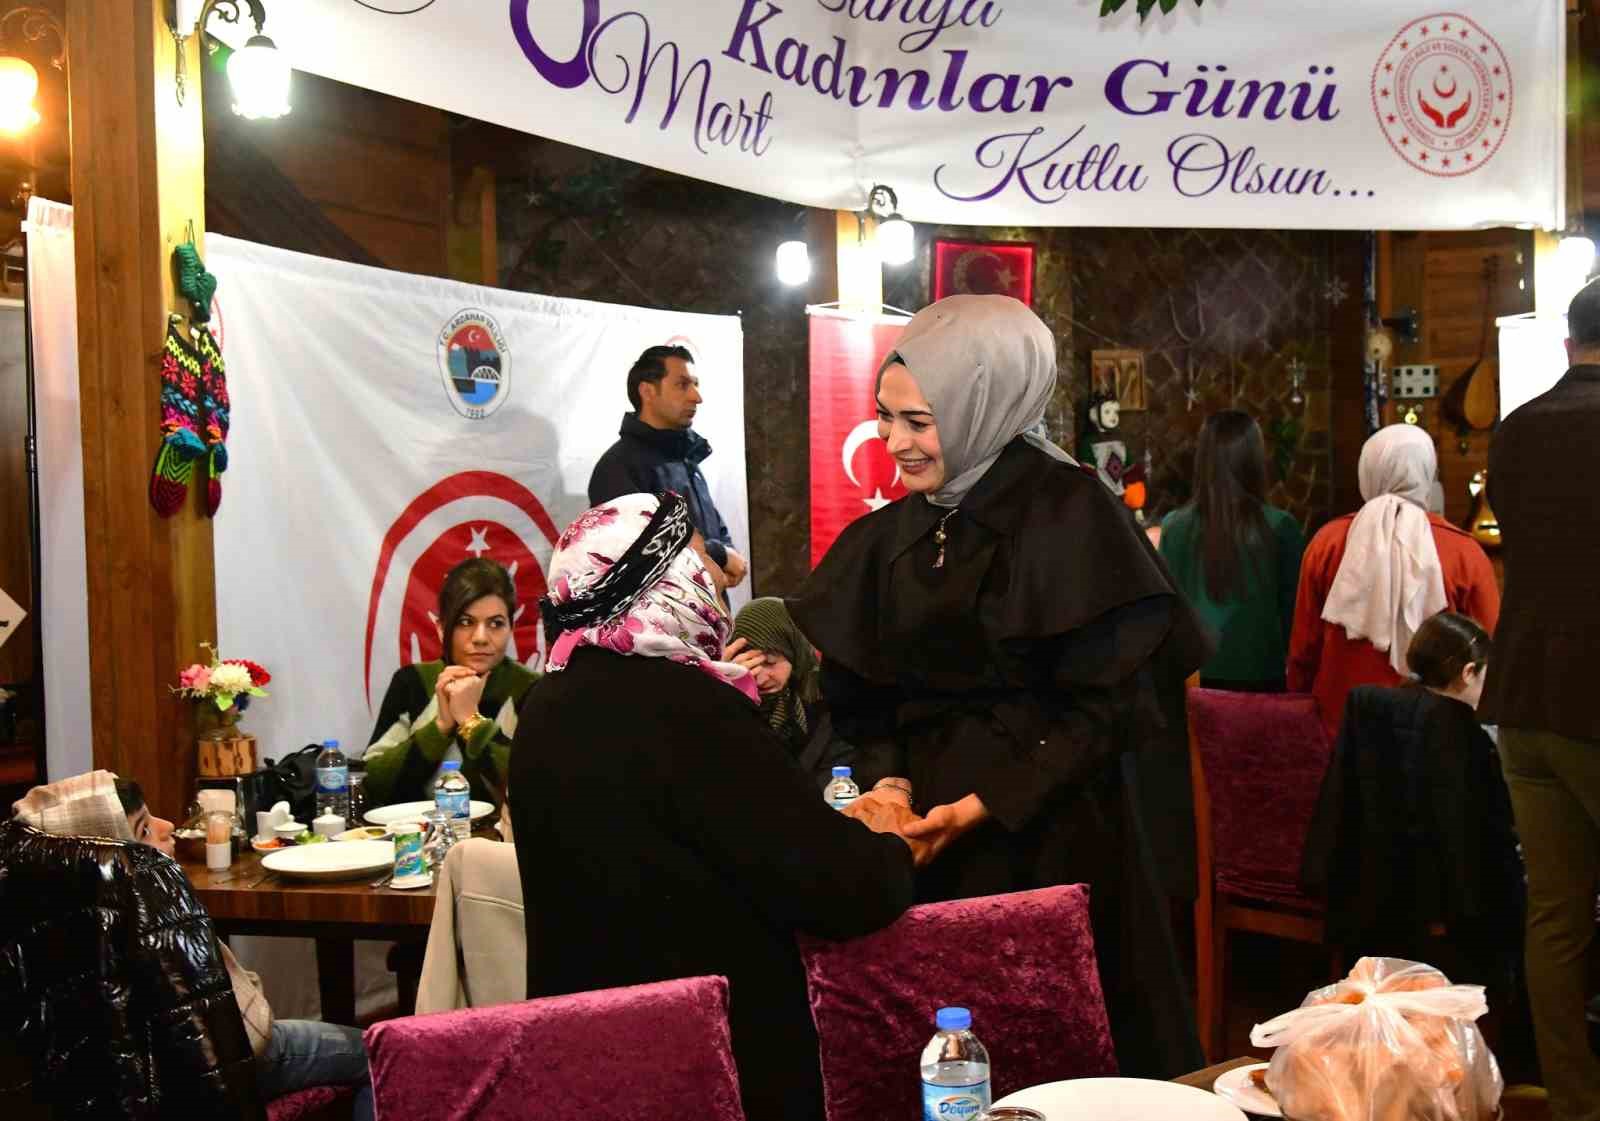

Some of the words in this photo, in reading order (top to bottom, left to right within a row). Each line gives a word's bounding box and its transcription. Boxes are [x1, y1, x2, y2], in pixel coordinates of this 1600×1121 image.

[588, 11, 773, 156] Mart
[721, 0, 1074, 113] Kadınlar
[1104, 58, 1340, 122] Günü
[934, 125, 1148, 205] Kutlu
[1166, 133, 1376, 199] Olsun...
